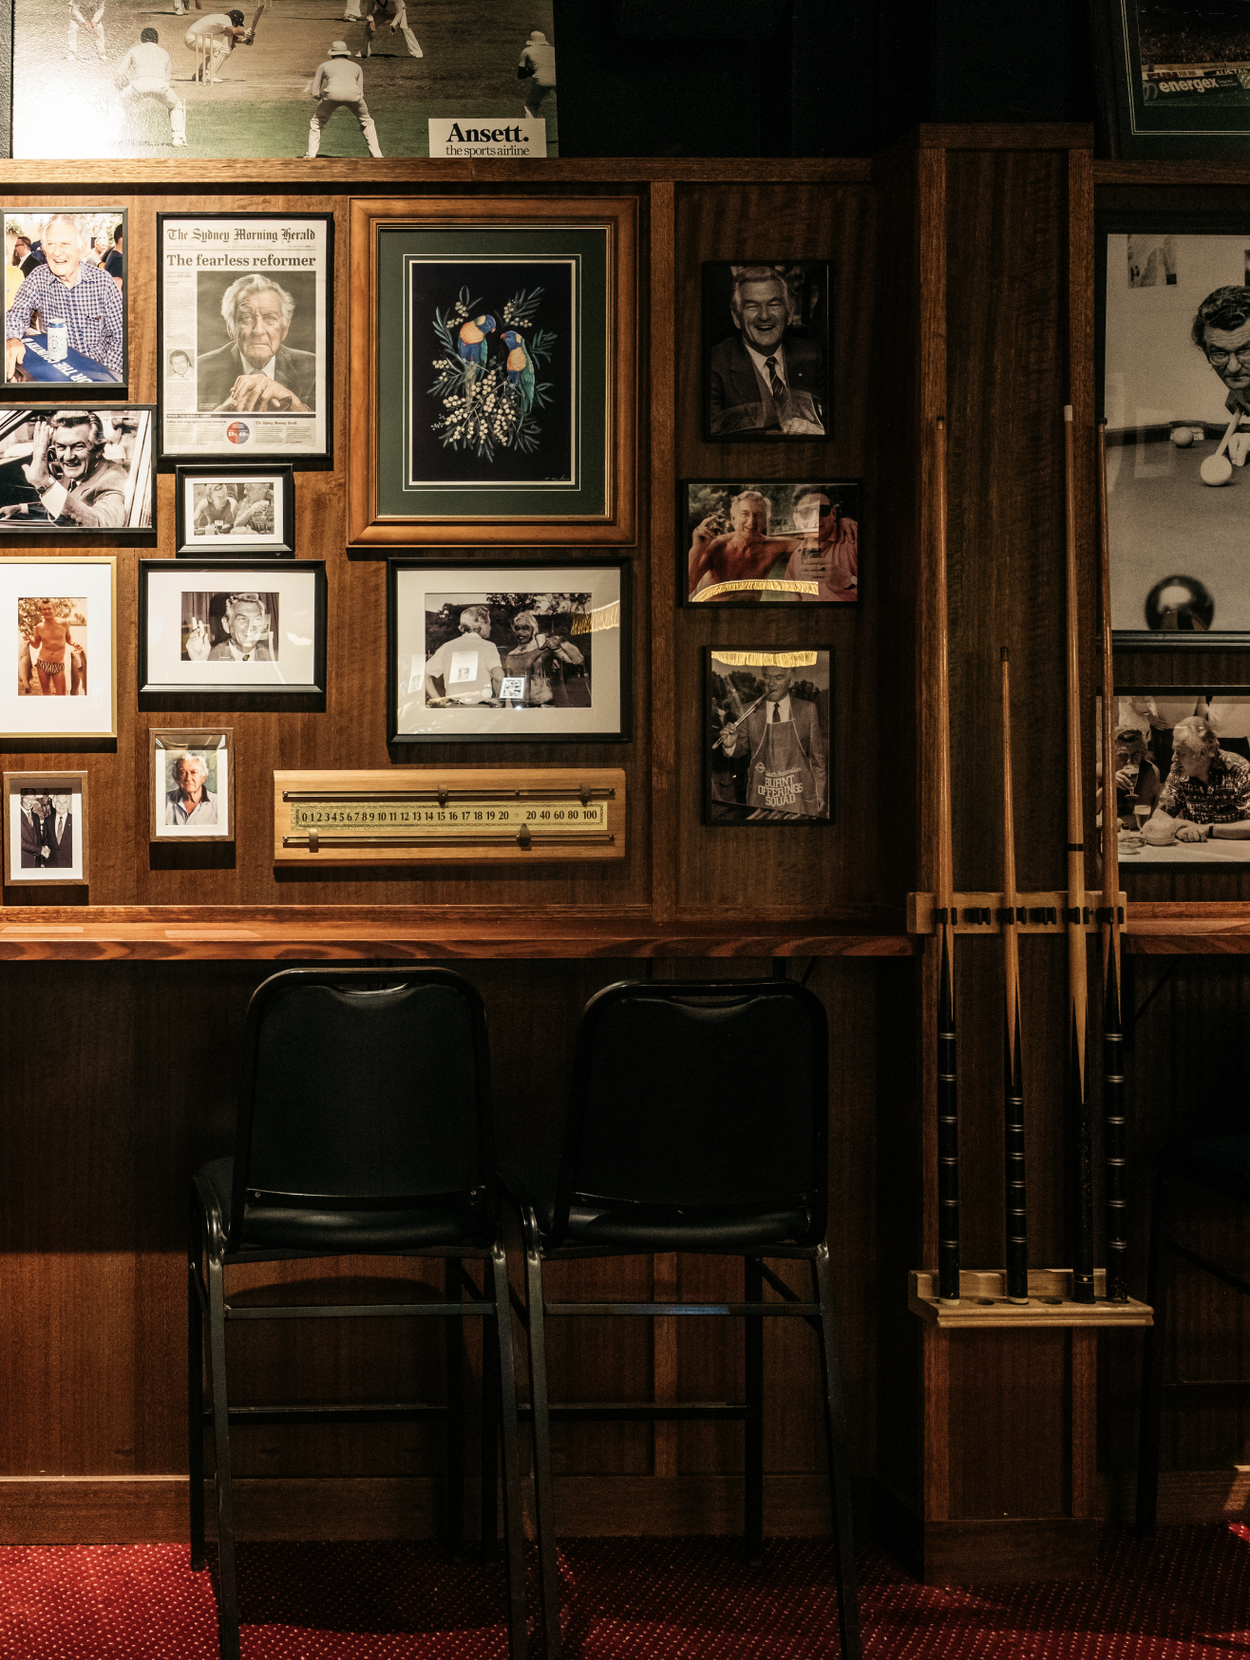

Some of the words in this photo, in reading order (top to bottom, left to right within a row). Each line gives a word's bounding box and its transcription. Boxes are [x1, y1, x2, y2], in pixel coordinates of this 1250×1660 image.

[1158, 78, 1220, 93] energex
[446, 122, 529, 143] Ansett.
[446, 145, 463, 156] the
[464, 145, 496, 157] sports
[497, 145, 529, 156] airline
[167, 228, 189, 241] The
[191, 227, 230, 243] Sydney
[234, 227, 278, 243] Morning
[281, 227, 316, 243] Herald
[166, 254, 193, 267] The
[196, 253, 250, 267] fearless
[252, 253, 316, 267] reformer
[53, 361, 79, 377] THE
[764, 774, 795, 788] BURNT
[758, 782, 804, 798] OFFERINGS
[765, 793, 796, 808] SQUAD
[301, 812, 308, 822] 0
[316, 812, 323, 822] 2
[324, 812, 331, 822] 3
[331, 812, 338, 822] 4
[339, 812, 345, 822] 5
[346, 812, 353, 822] 6
[353, 812, 360, 822] 7
[361, 812, 368, 822] 8
[368, 812, 375, 822] 9
[377, 811, 387, 821] 10
[389, 811, 397, 821] 11
[400, 811, 410, 821] 12
[412, 811, 422, 821] 13
[424, 811, 434, 821] 14
[436, 811, 446, 821] 15
[448, 811, 459, 821] 16
[461, 811, 471, 821] 17
[473, 811, 483, 821] 18
[486, 811, 496, 821] 19
[498, 811, 510, 821] 20
[525, 811, 537, 821] 20
[539, 810, 551, 820] 40
[553, 810, 565, 820] 60
[567, 810, 579, 820] 80
[582, 810, 598, 820] 100
